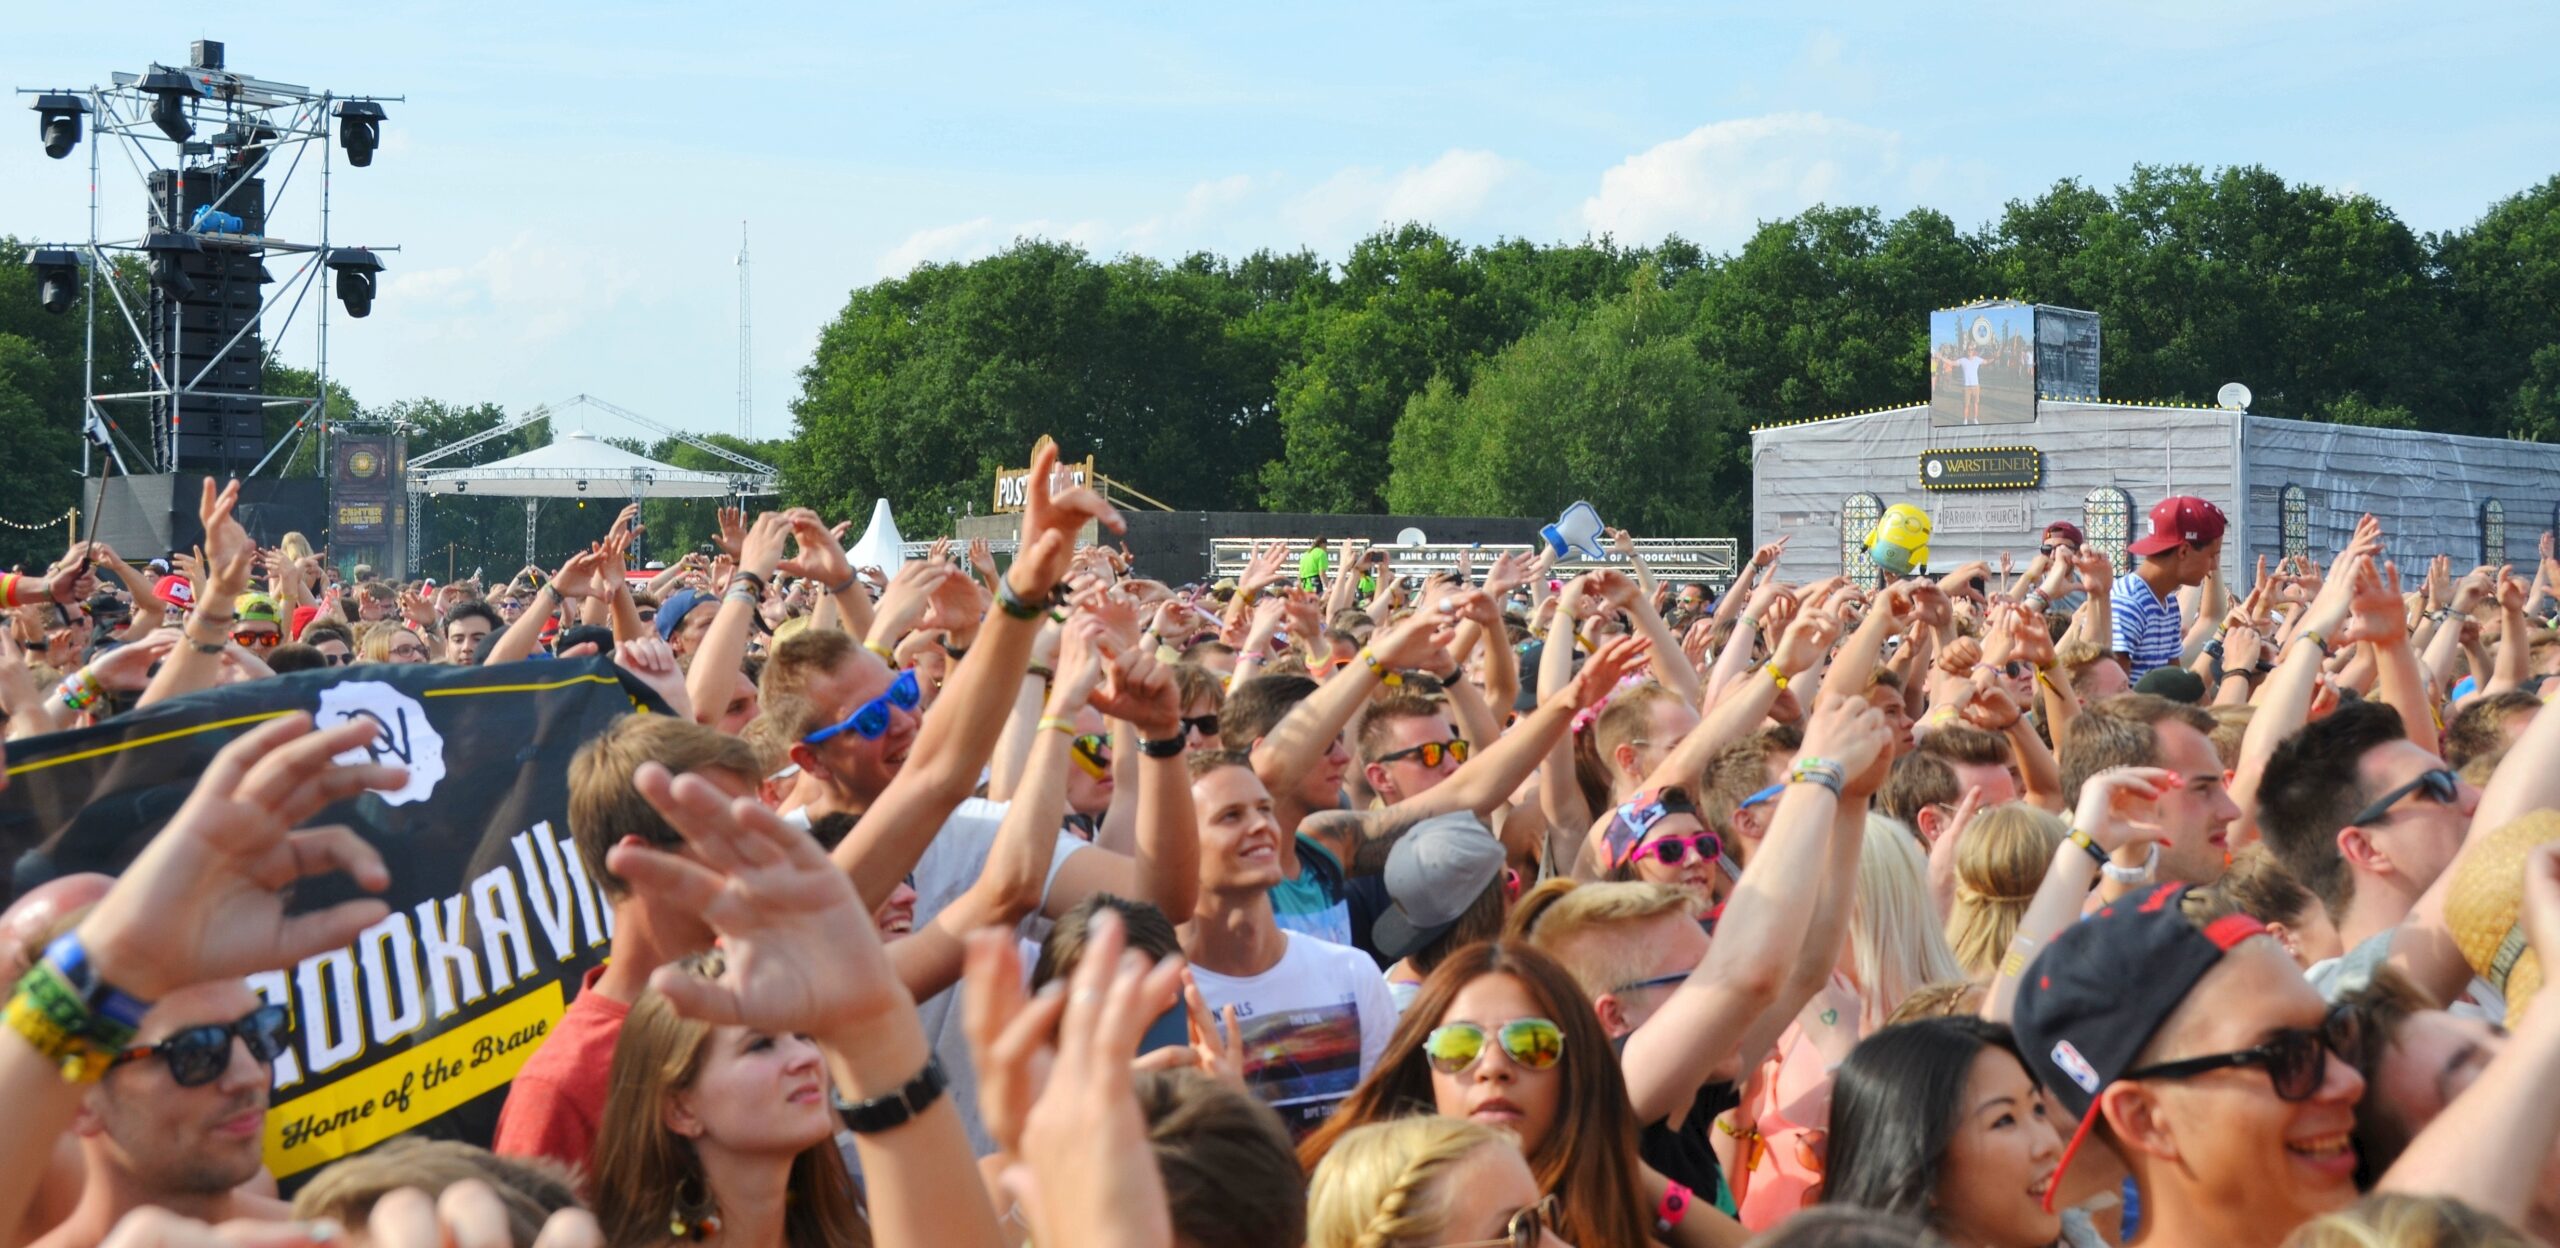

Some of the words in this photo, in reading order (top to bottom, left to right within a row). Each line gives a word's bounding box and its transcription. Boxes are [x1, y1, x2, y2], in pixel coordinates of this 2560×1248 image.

[1945, 458, 2031, 472] WARSTEINER
[340, 507, 382, 516] CENTER
[1985, 508, 2019, 524] CHURCH
[340, 516, 382, 525] SHELTER
[1400, 552, 1422, 561] BANK
[1425, 552, 1437, 561] OF
[1610, 553, 1622, 562] OF
[281, 1098, 376, 1150] Home
[382, 1071, 414, 1114] of
[422, 1053, 465, 1092] the
[470, 1018, 549, 1069] Brave
